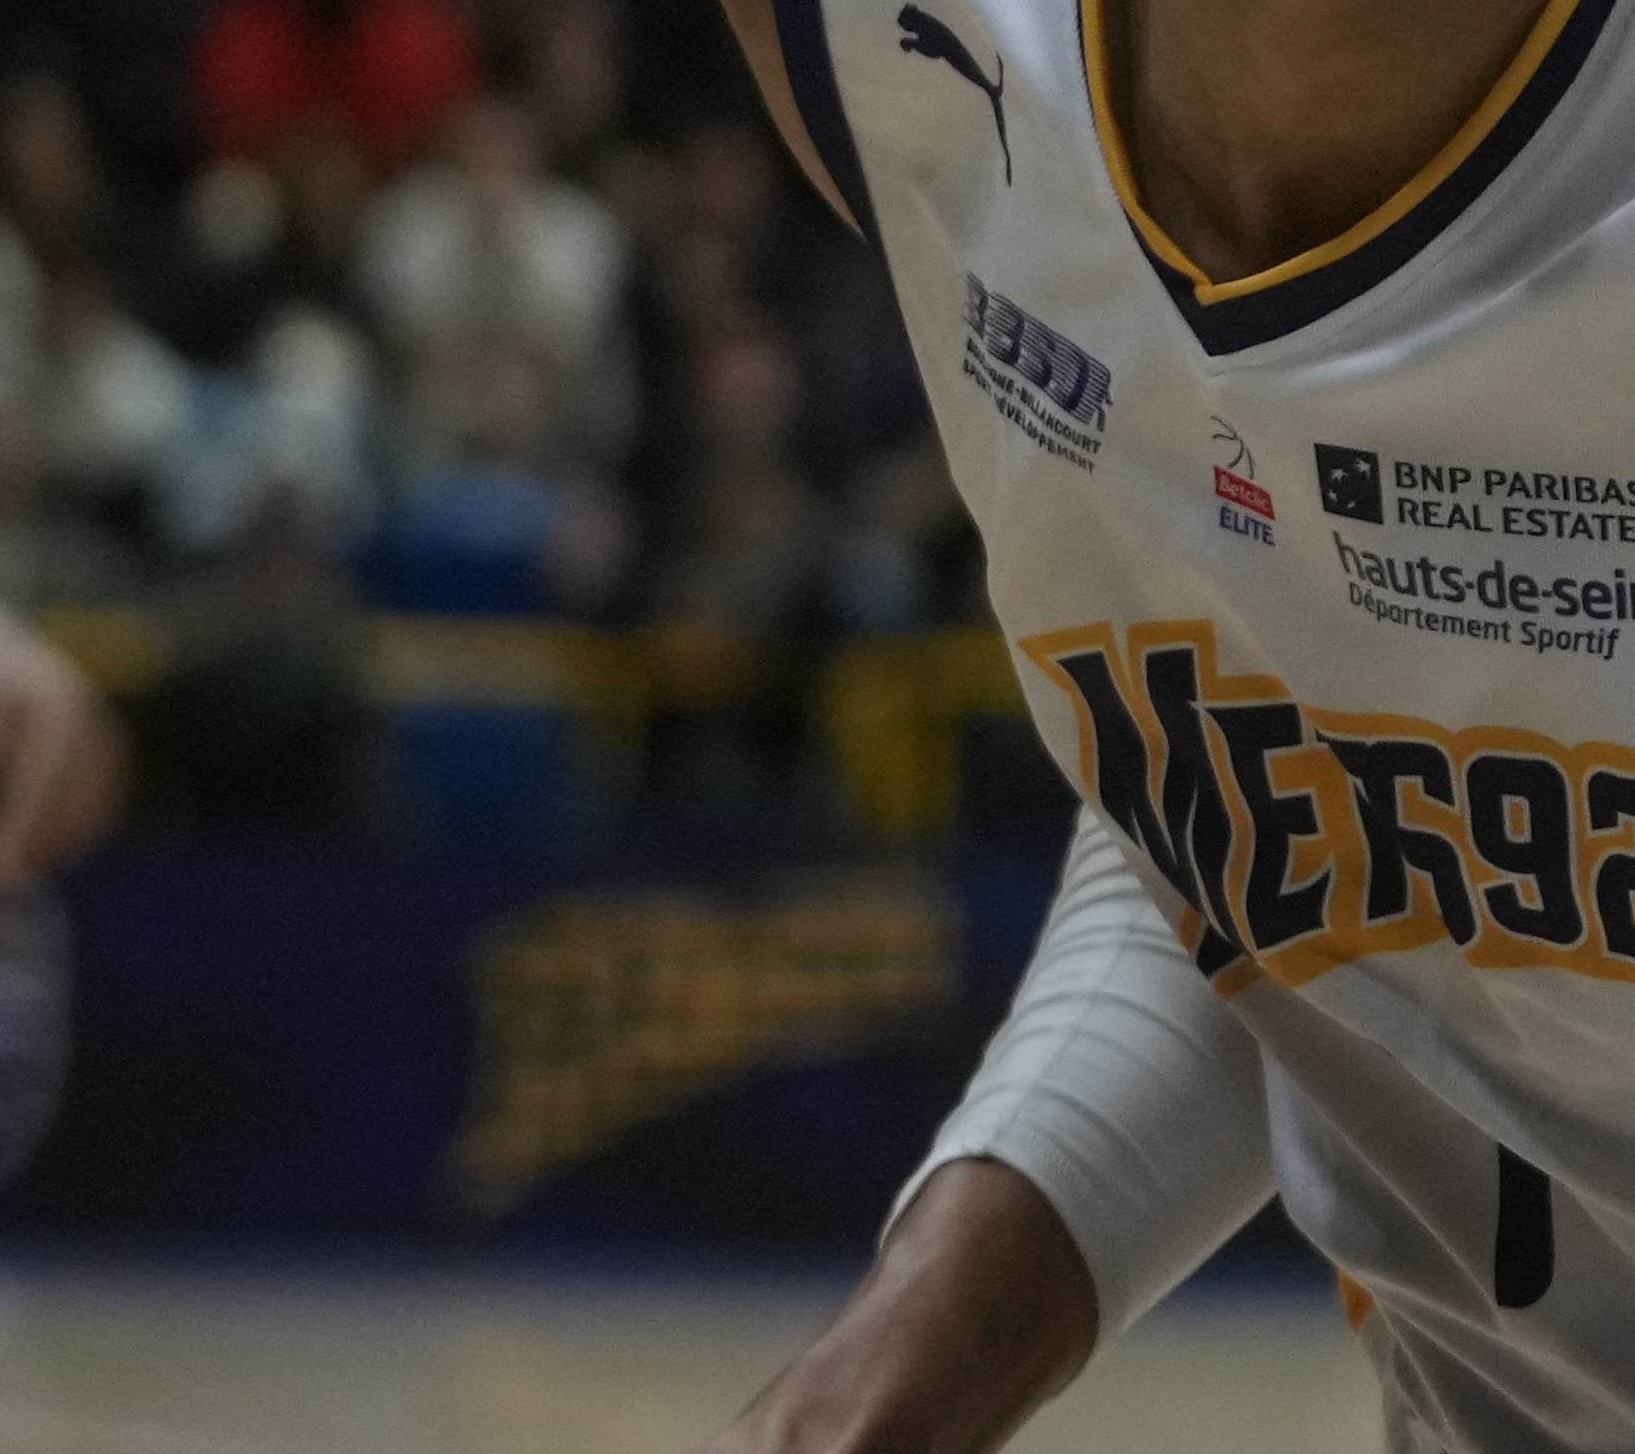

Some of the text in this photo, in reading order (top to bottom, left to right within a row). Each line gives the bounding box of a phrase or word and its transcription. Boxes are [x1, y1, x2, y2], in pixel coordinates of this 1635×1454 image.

[1394, 461, 1472, 494] BNP
[1220, 506, 1276, 547] ELITE
[1397, 498, 1493, 533] REAL
[1348, 581, 1620, 660] Département Sportif
